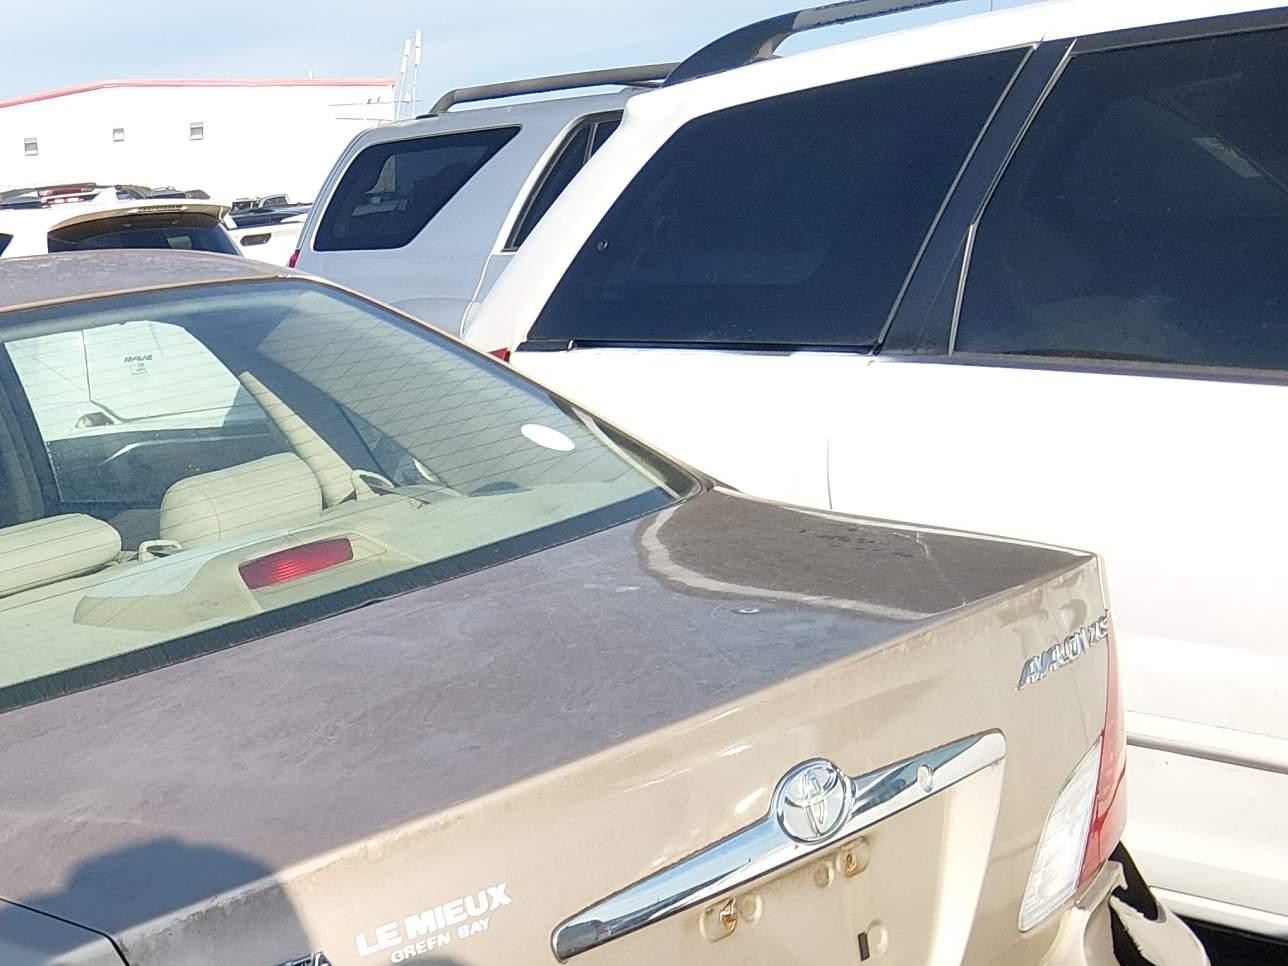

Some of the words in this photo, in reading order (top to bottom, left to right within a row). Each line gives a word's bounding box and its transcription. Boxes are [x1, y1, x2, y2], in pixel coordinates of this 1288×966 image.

[1016, 627, 1088, 691] AVALON
[355, 920, 403, 957] LE
[404, 882, 513, 940] MIEUX
[457, 915, 490, 940] BAY
